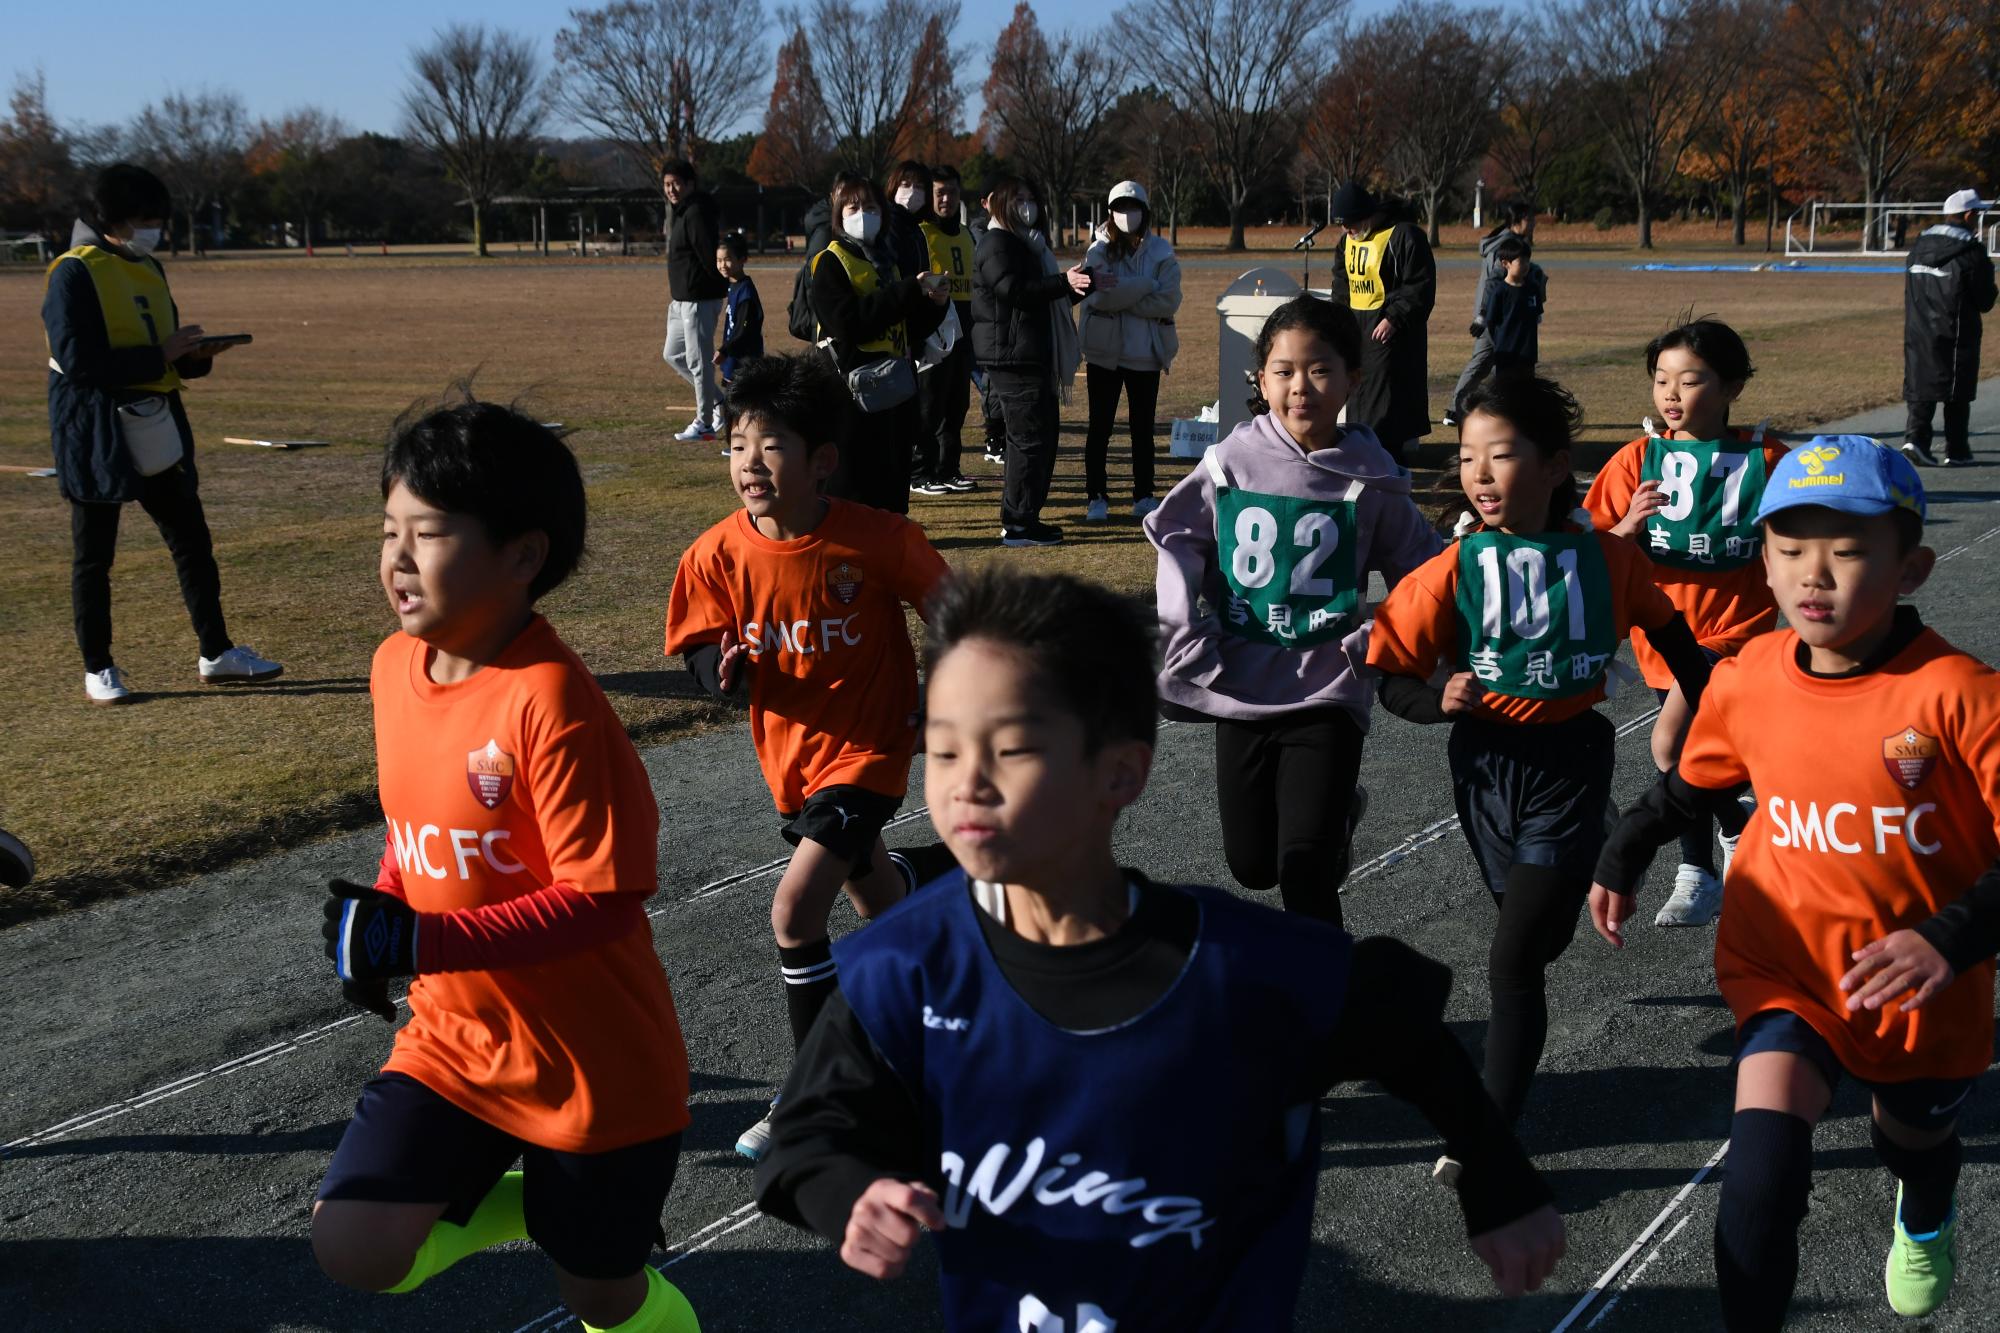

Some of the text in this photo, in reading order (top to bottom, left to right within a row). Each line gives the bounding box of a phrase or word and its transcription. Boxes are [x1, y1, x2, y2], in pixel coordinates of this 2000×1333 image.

[951, 246, 964, 275] 8
[1349, 245, 1369, 276] 30
[1656, 451, 1749, 527] 87
[1788, 472, 1845, 489] hummel
[1232, 506, 1339, 596] 82
[1648, 522, 1760, 565] 吉見町
[1477, 546, 1586, 641] 101
[743, 611, 862, 656] SMC FC
[1469, 643, 1611, 690] 吉見町
[476, 759, 505, 773] SMC
[1894, 745, 1929, 757] SMC
[1768, 796, 1942, 855] SMC FC
[448, 828, 526, 880] FC
